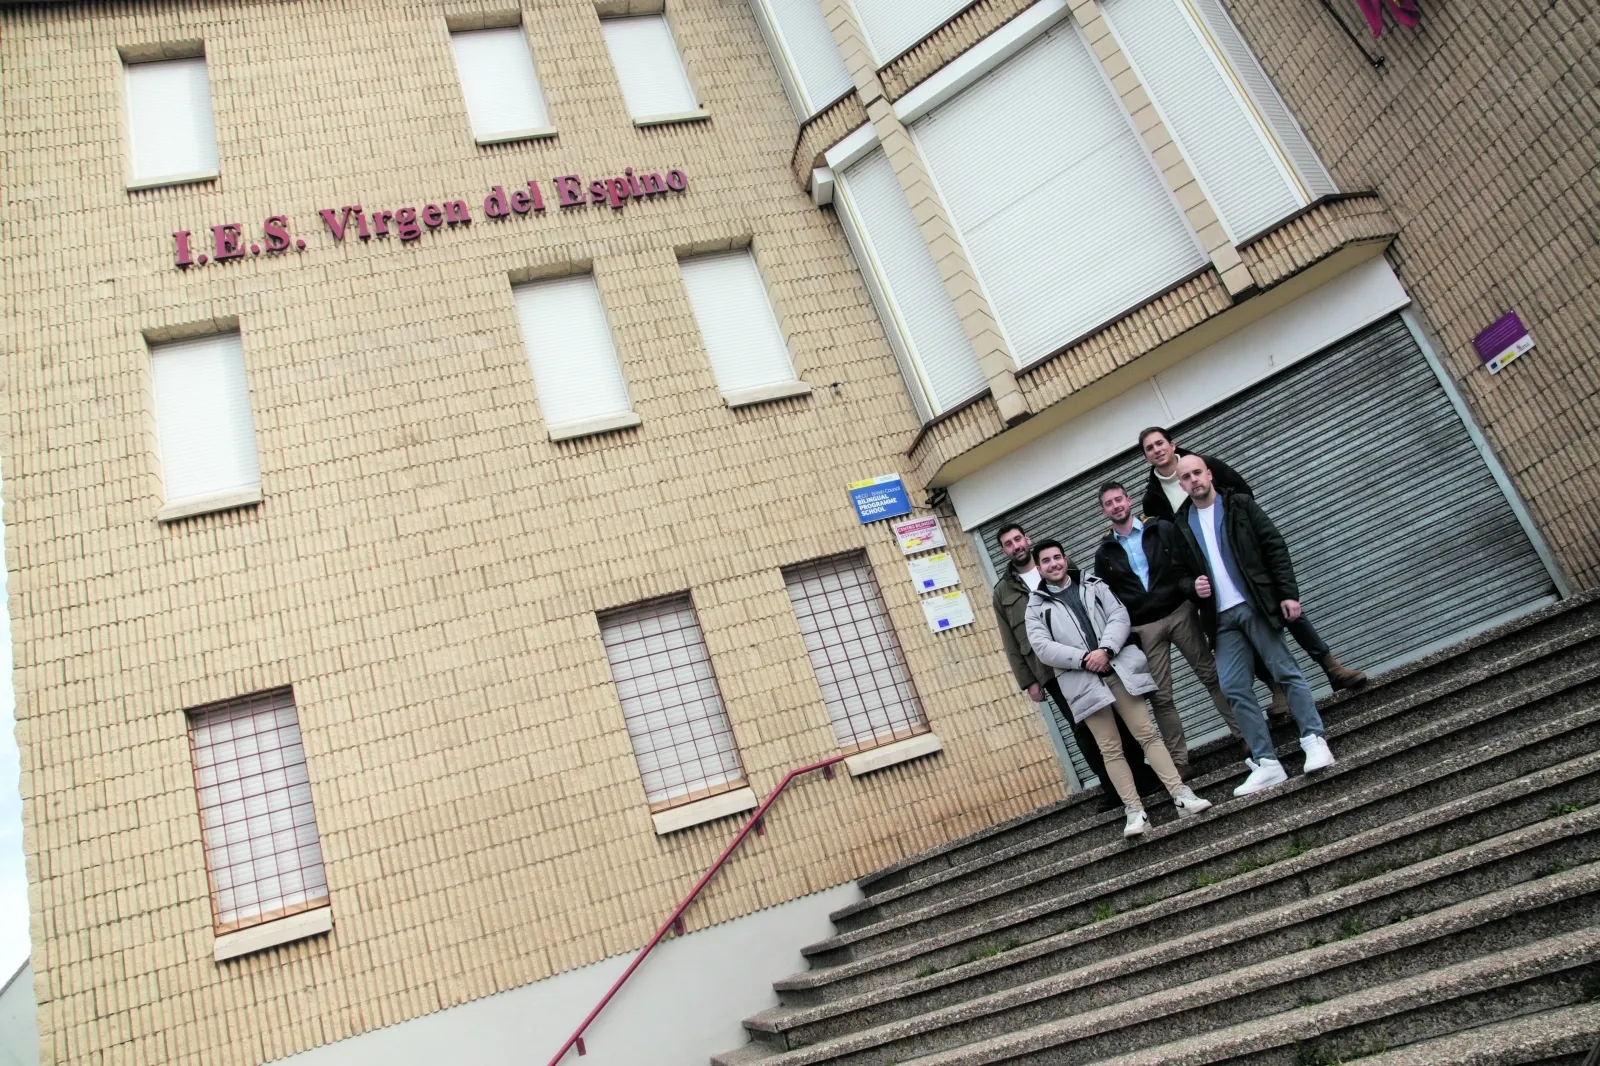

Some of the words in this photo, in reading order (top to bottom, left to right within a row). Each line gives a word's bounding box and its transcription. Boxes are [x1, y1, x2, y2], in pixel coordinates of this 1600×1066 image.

[172, 214, 306, 266] I.E.S.
[319, 200, 472, 241] Virgen
[484, 180, 545, 218] del
[553, 167, 687, 209] Espino
[857, 494, 889, 505] BILINGUAL
[859, 498, 897, 510] PROGRAMME
[861, 506, 886, 516] SCHOOL
